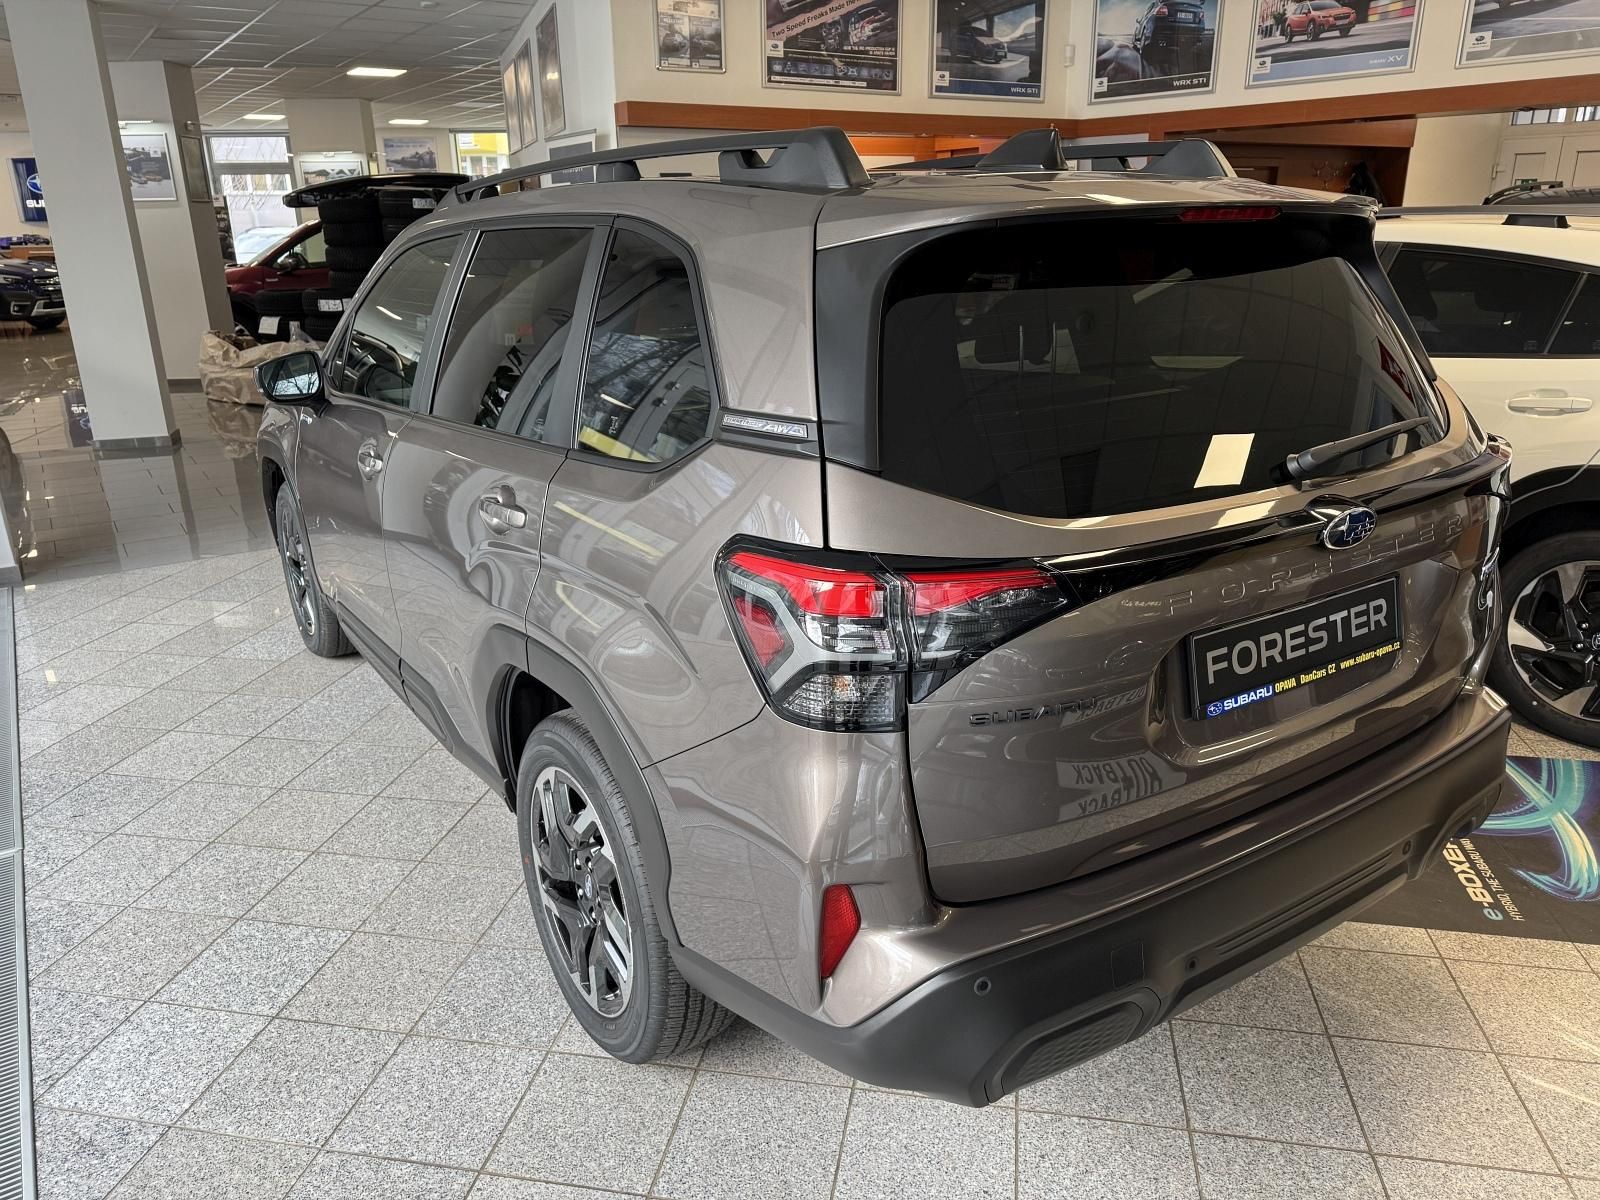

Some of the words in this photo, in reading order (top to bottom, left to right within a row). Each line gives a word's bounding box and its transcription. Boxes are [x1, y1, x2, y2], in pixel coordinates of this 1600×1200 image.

[771, 27, 785, 38] Two
[786, 17, 806, 32] Speed
[807, 9, 829, 25] Freaks
[829, 2, 846, 14] Made
[1387, 54, 1405, 63] XV
[1173, 79, 1191, 87] WRX
[1191, 77, 1207, 85] STI
[1206, 598, 1387, 684] FORESTER
[1224, 685, 1273, 711] SUBARU
[1275, 677, 1297, 692] OPAVA
[1300, 670, 1327, 684] DanCars
[1328, 663, 1336, 675] CZ
[1340, 642, 1401, 670] www.subaru-opava.cz
[969, 698, 1097, 727] SUBARU
[1468, 847, 1495, 879] SUBARU
[1486, 878, 1504, 892] THE
